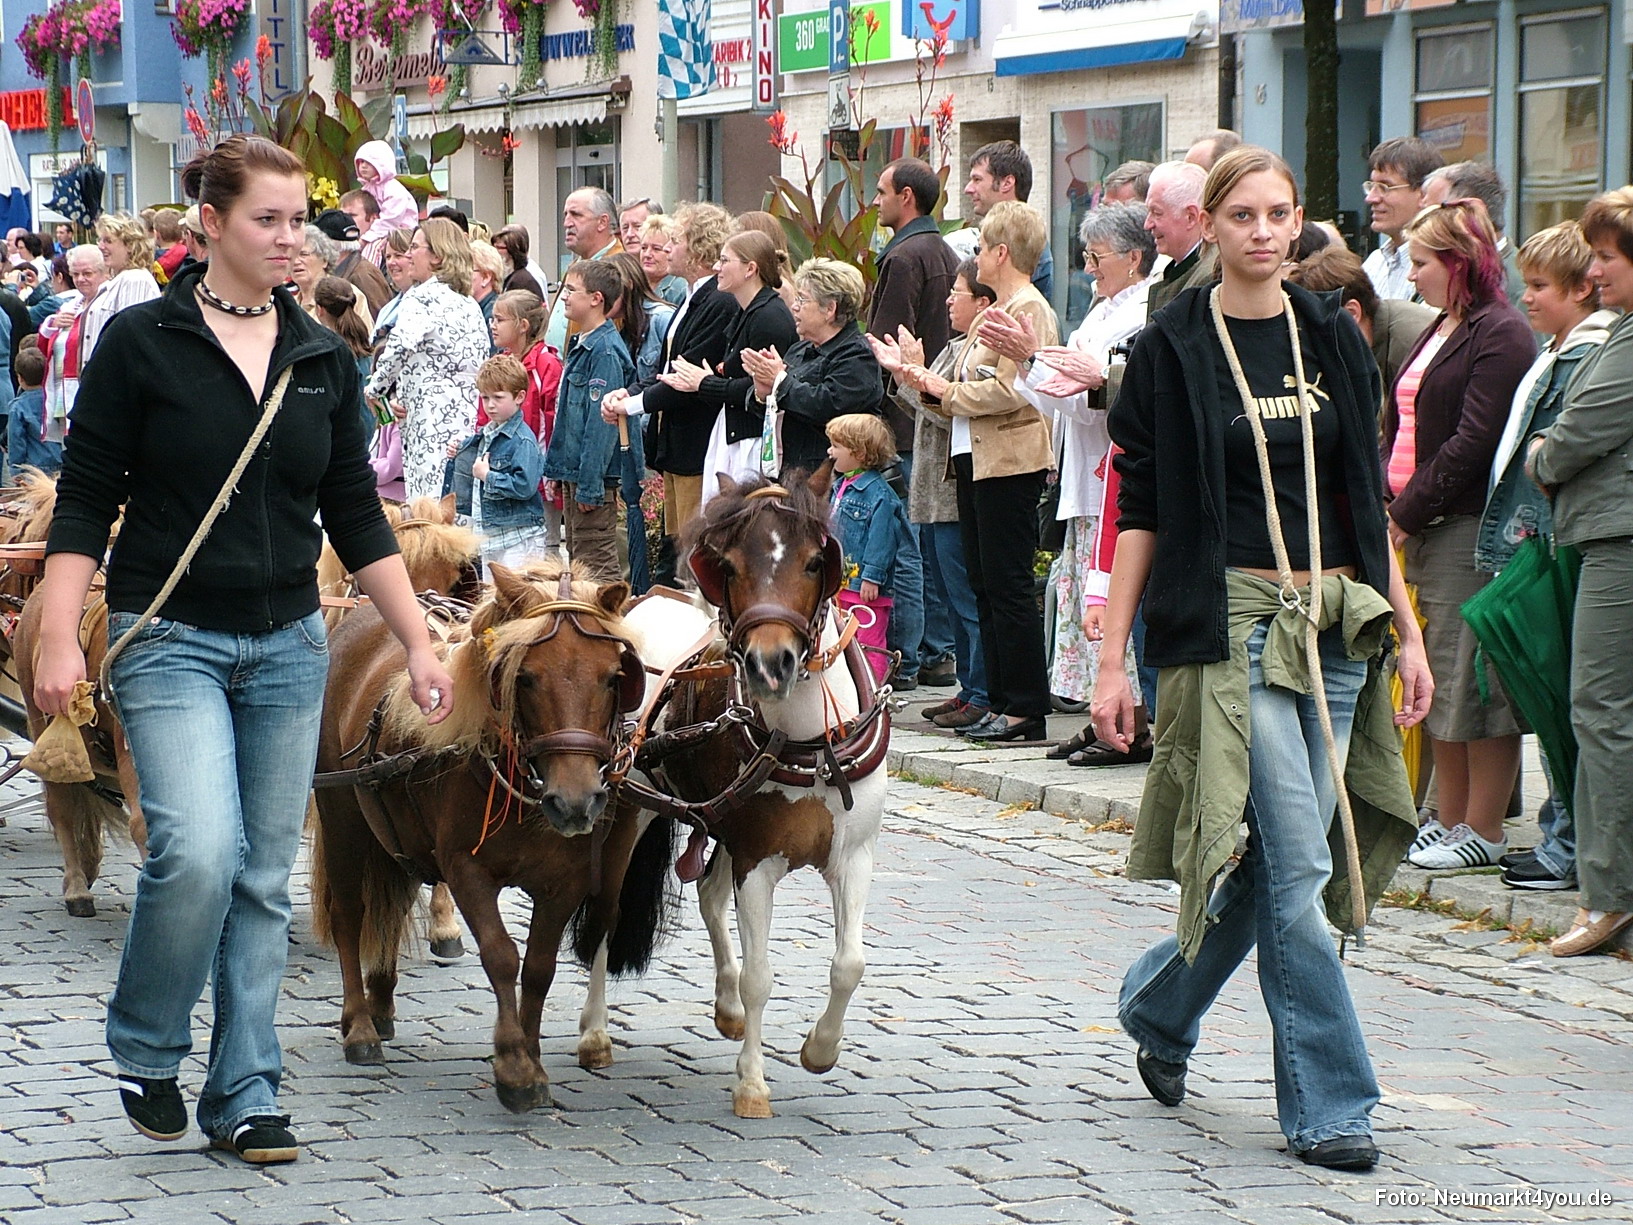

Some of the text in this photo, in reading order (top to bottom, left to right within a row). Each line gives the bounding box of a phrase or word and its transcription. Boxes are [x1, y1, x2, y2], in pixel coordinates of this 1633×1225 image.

[758, 0, 772, 103] KINO
[795, 19, 815, 51] 360
[833, 6, 845, 64] P
